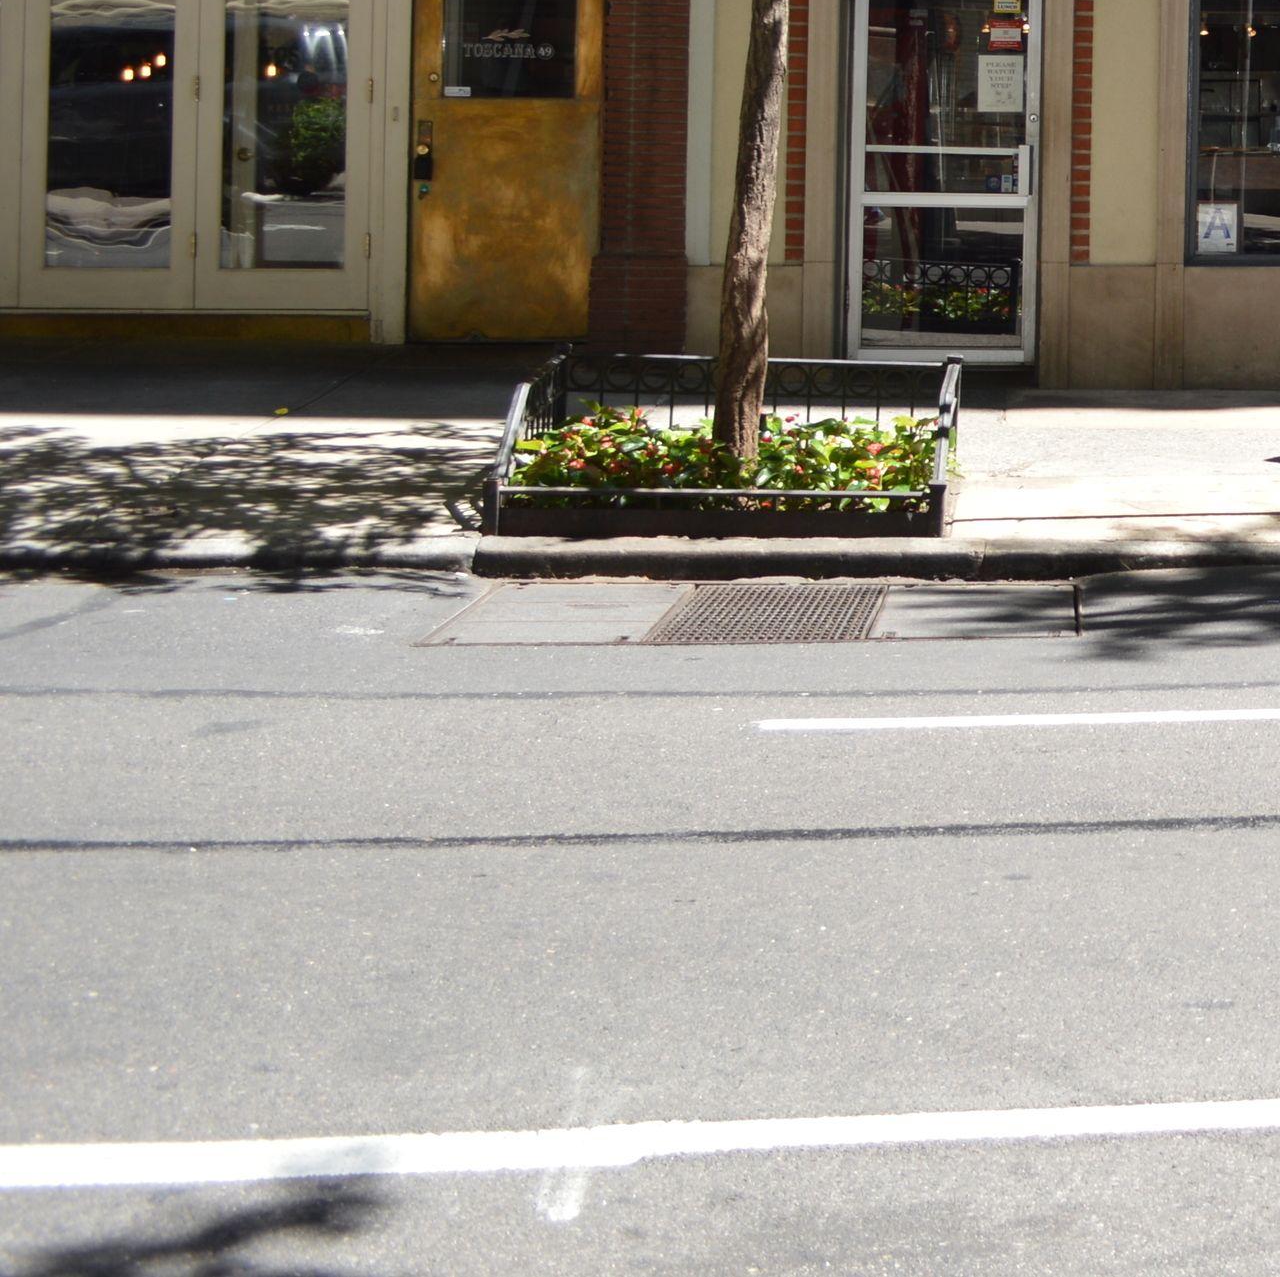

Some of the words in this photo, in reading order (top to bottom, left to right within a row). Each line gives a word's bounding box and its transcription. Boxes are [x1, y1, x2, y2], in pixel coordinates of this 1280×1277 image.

[464, 43, 537, 59] TOSCANA
[538, 46, 553, 57] 49
[1203, 208, 1232, 239] A
